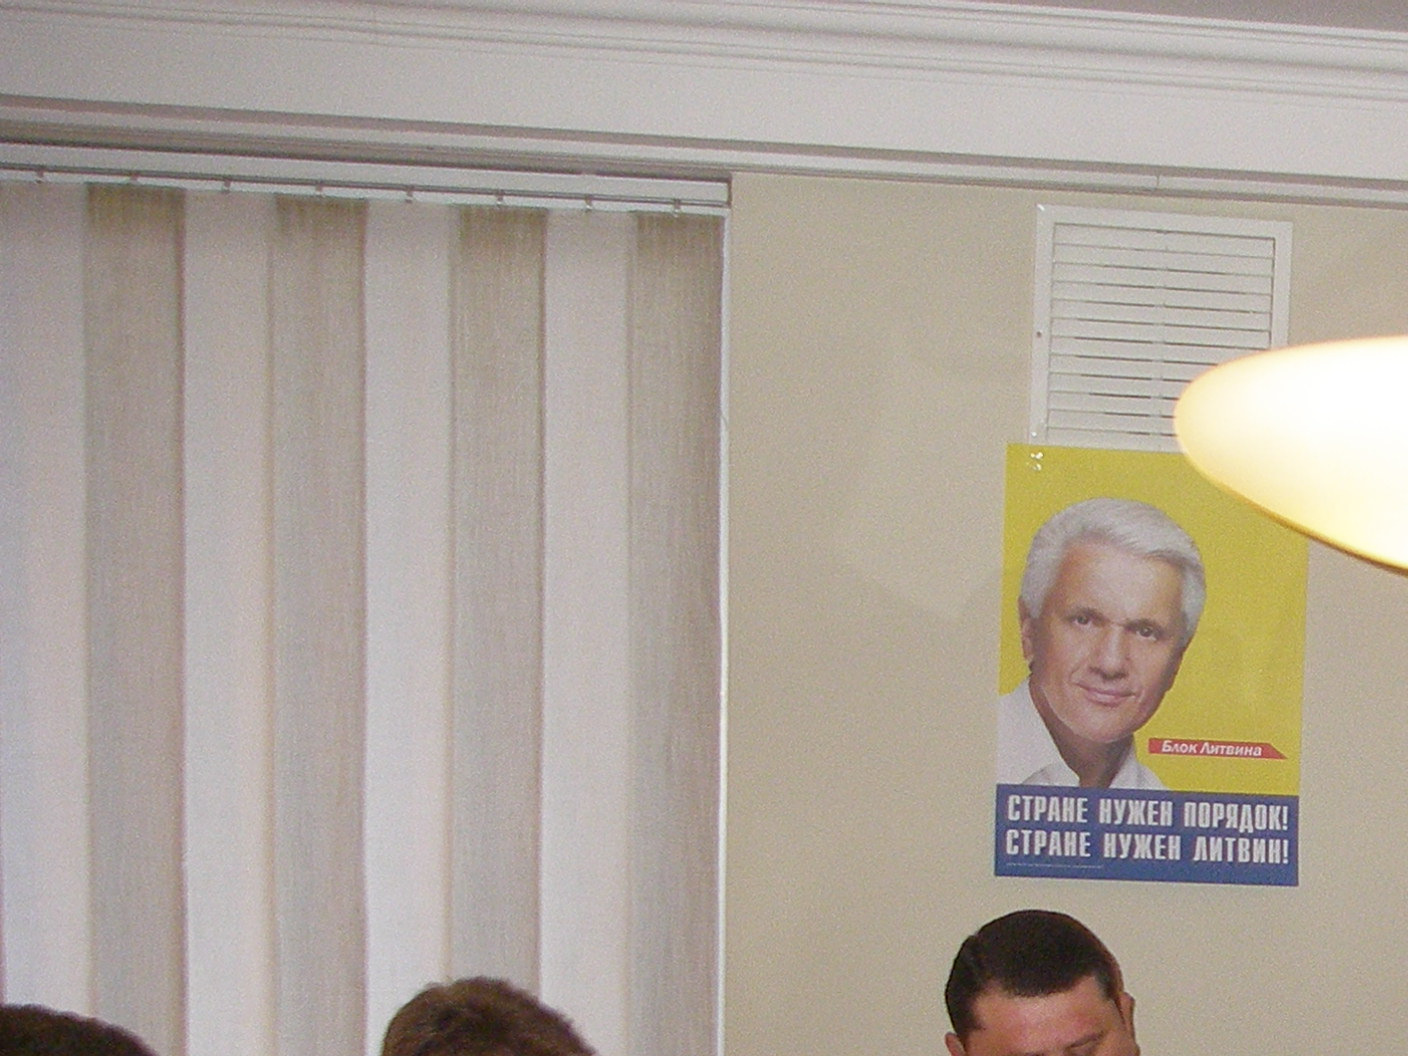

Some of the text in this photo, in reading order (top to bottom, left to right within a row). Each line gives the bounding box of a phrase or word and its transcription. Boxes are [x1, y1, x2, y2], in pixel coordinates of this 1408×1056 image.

[1161, 740, 1263, 757] Блок Литвина
[1007, 794, 1289, 834] СТРАНЕ НУЖЕН ПОРЯДОК!
[1005, 828, 1289, 864] СТРАНЕ НУЖЕН ЛИТВИН!
